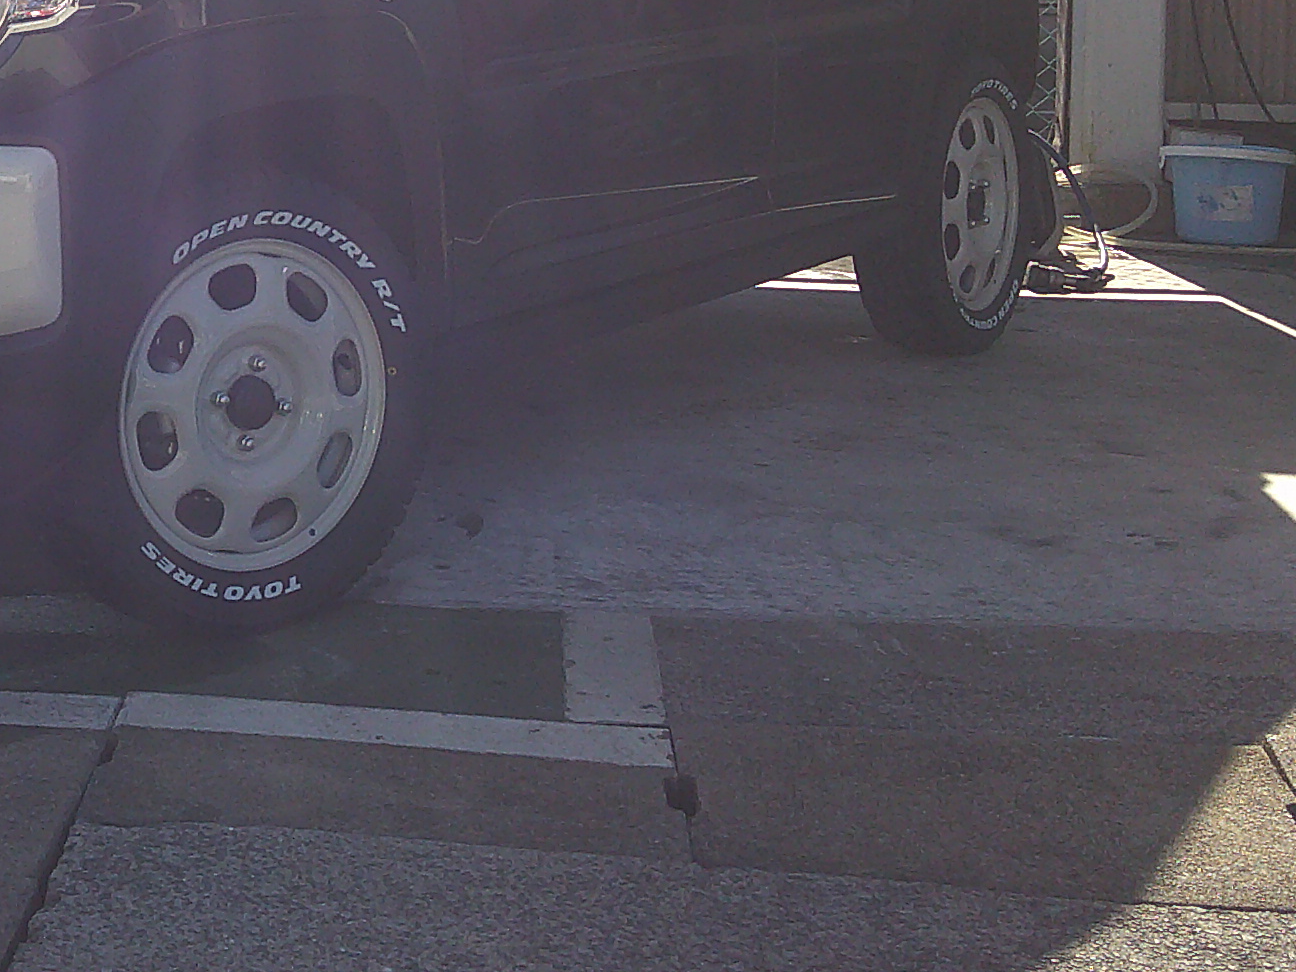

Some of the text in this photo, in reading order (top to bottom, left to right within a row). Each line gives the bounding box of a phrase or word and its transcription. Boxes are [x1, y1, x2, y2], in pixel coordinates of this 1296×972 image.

[172, 210, 407, 333] OPEN COUNTRY R/T
[140, 541, 302, 601] TOYO TIRES
